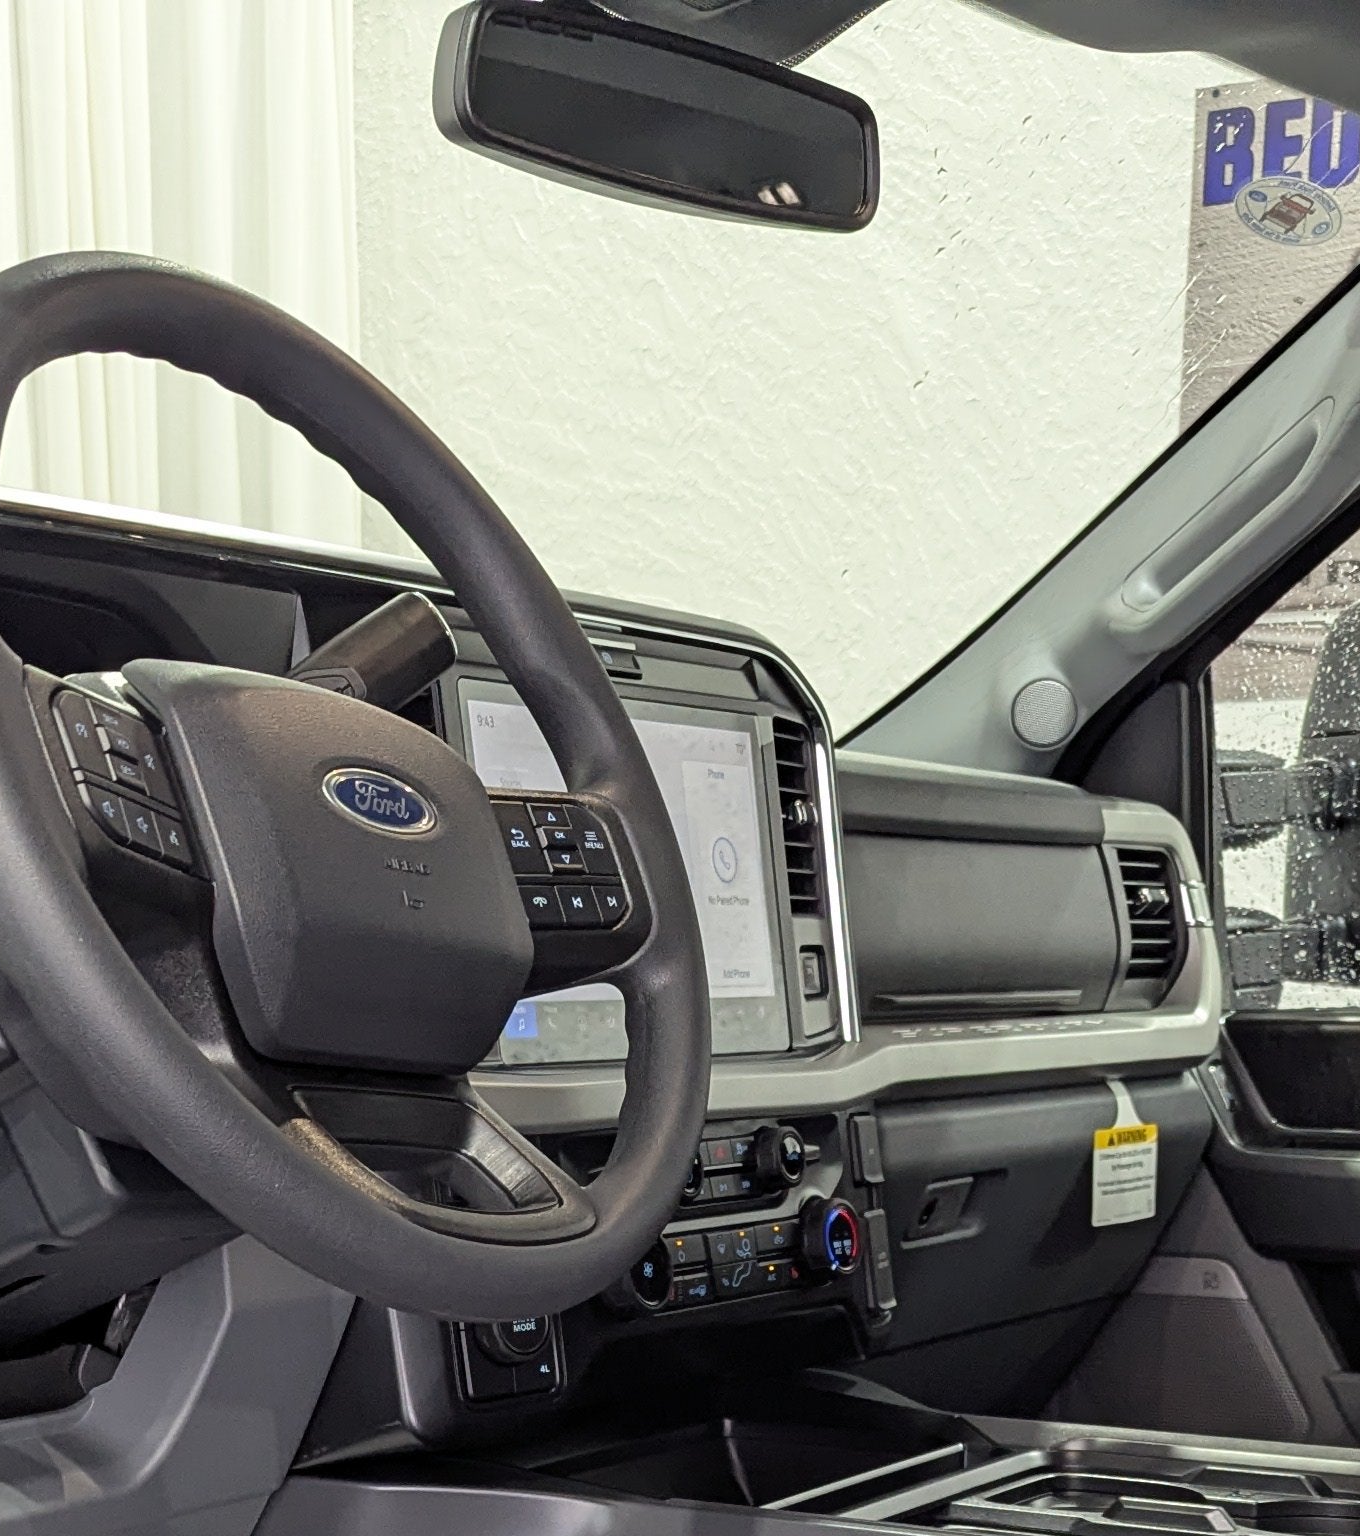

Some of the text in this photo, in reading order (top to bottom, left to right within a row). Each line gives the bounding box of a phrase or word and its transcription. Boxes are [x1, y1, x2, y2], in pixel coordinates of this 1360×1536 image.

[354, 780, 410, 820] Ford
[510, 840, 531, 848] BACK
[584, 841, 605, 850] MENU
[540, 1364, 551, 1373] 4L
